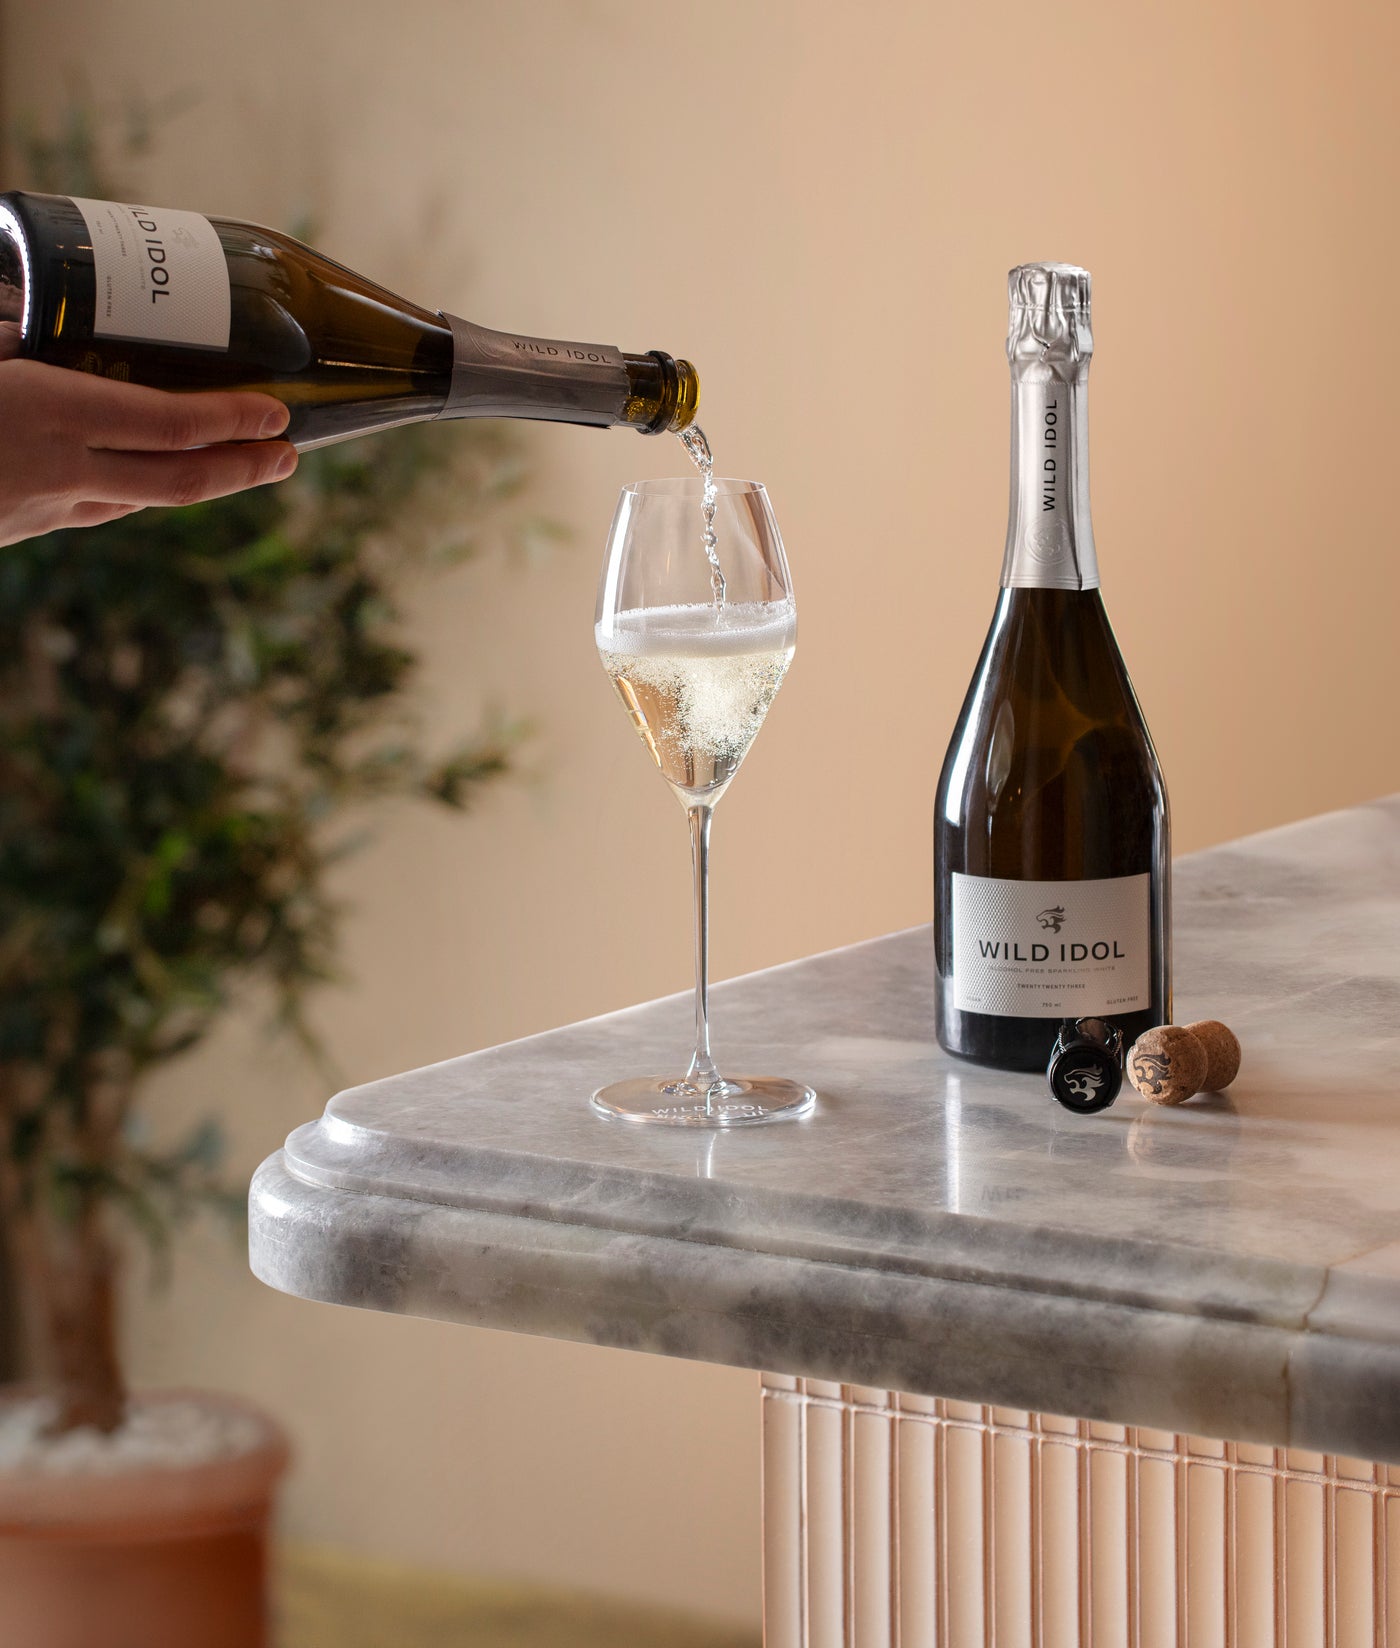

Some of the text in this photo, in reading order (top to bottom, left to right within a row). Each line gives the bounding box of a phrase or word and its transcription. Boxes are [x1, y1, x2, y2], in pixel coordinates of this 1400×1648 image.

[145, 238, 170, 304] IDOL
[512, 339, 612, 364] WILD IDOL
[1042, 399, 1058, 512] WILD IDOL
[978, 939, 1126, 962] WILD IDOL
[1106, 997, 1126, 1005] GLUTEN
[651, 1104, 769, 1115] WILD IDOL
